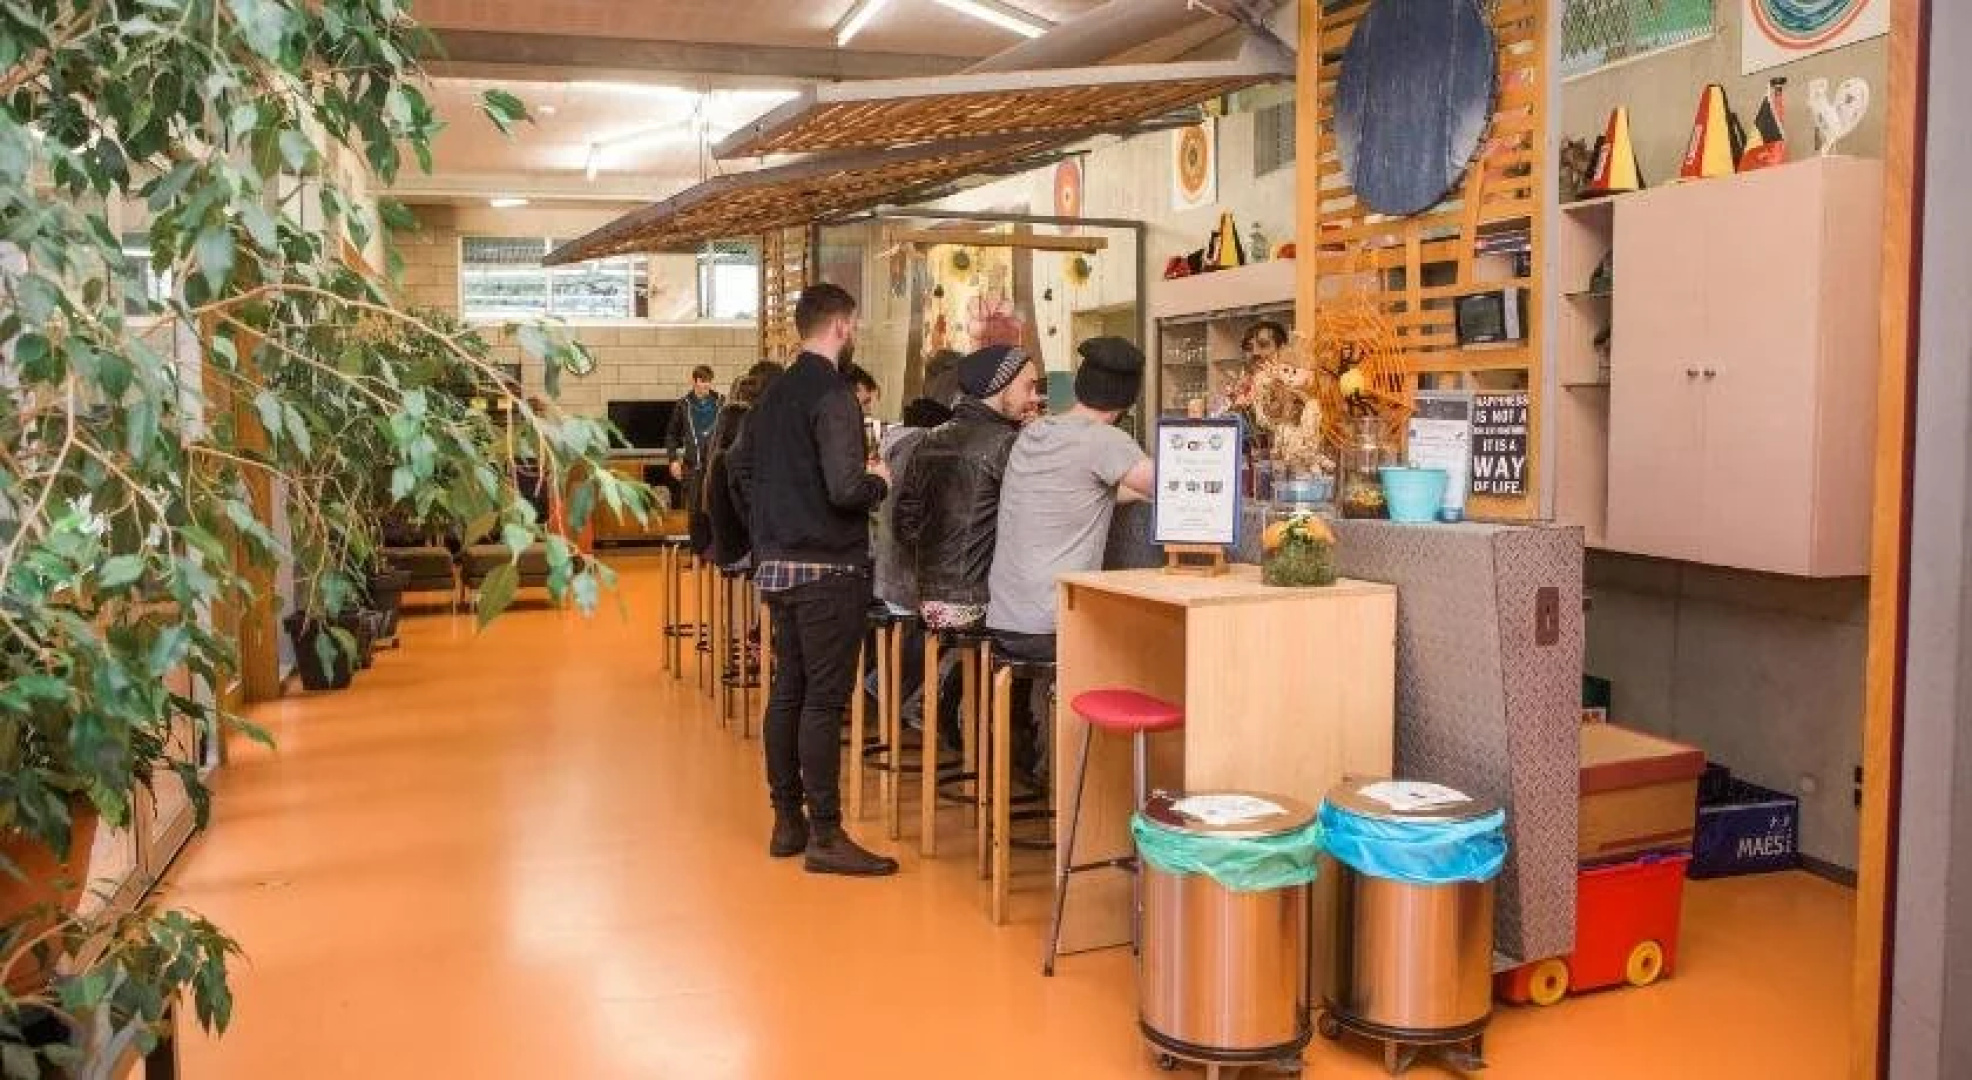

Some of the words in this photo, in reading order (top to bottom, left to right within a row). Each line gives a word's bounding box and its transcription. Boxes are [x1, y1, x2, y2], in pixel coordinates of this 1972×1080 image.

[1474, 409, 1487, 424] IS
[1492, 408, 1515, 424] NOT
[1483, 438, 1494, 452] IT
[1495, 438, 1507, 452] IS
[1508, 438, 1518, 452] A
[1473, 454, 1525, 479] WAY
[1473, 480, 1490, 493] OF
